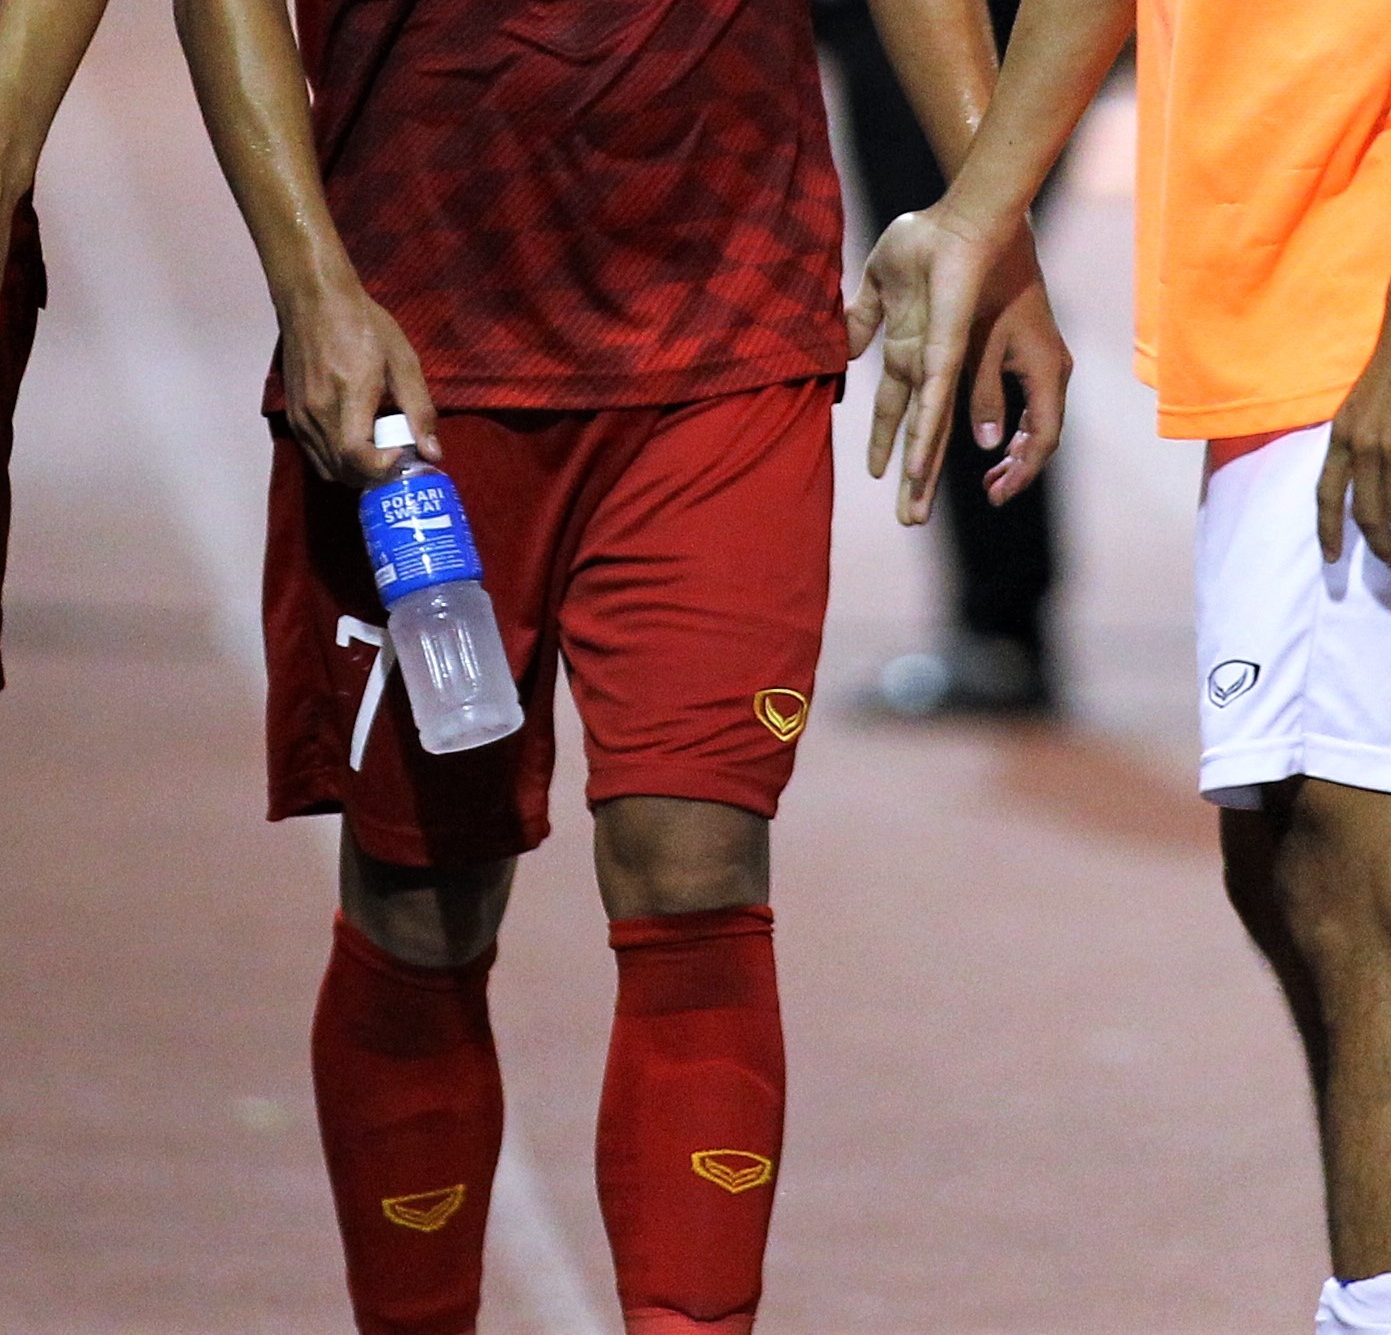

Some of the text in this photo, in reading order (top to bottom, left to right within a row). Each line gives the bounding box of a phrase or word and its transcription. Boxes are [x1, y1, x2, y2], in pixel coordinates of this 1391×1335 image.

[381, 488, 445, 513] POCARI
[384, 499, 441, 523] SWEAT
[336, 615, 393, 772] 7
